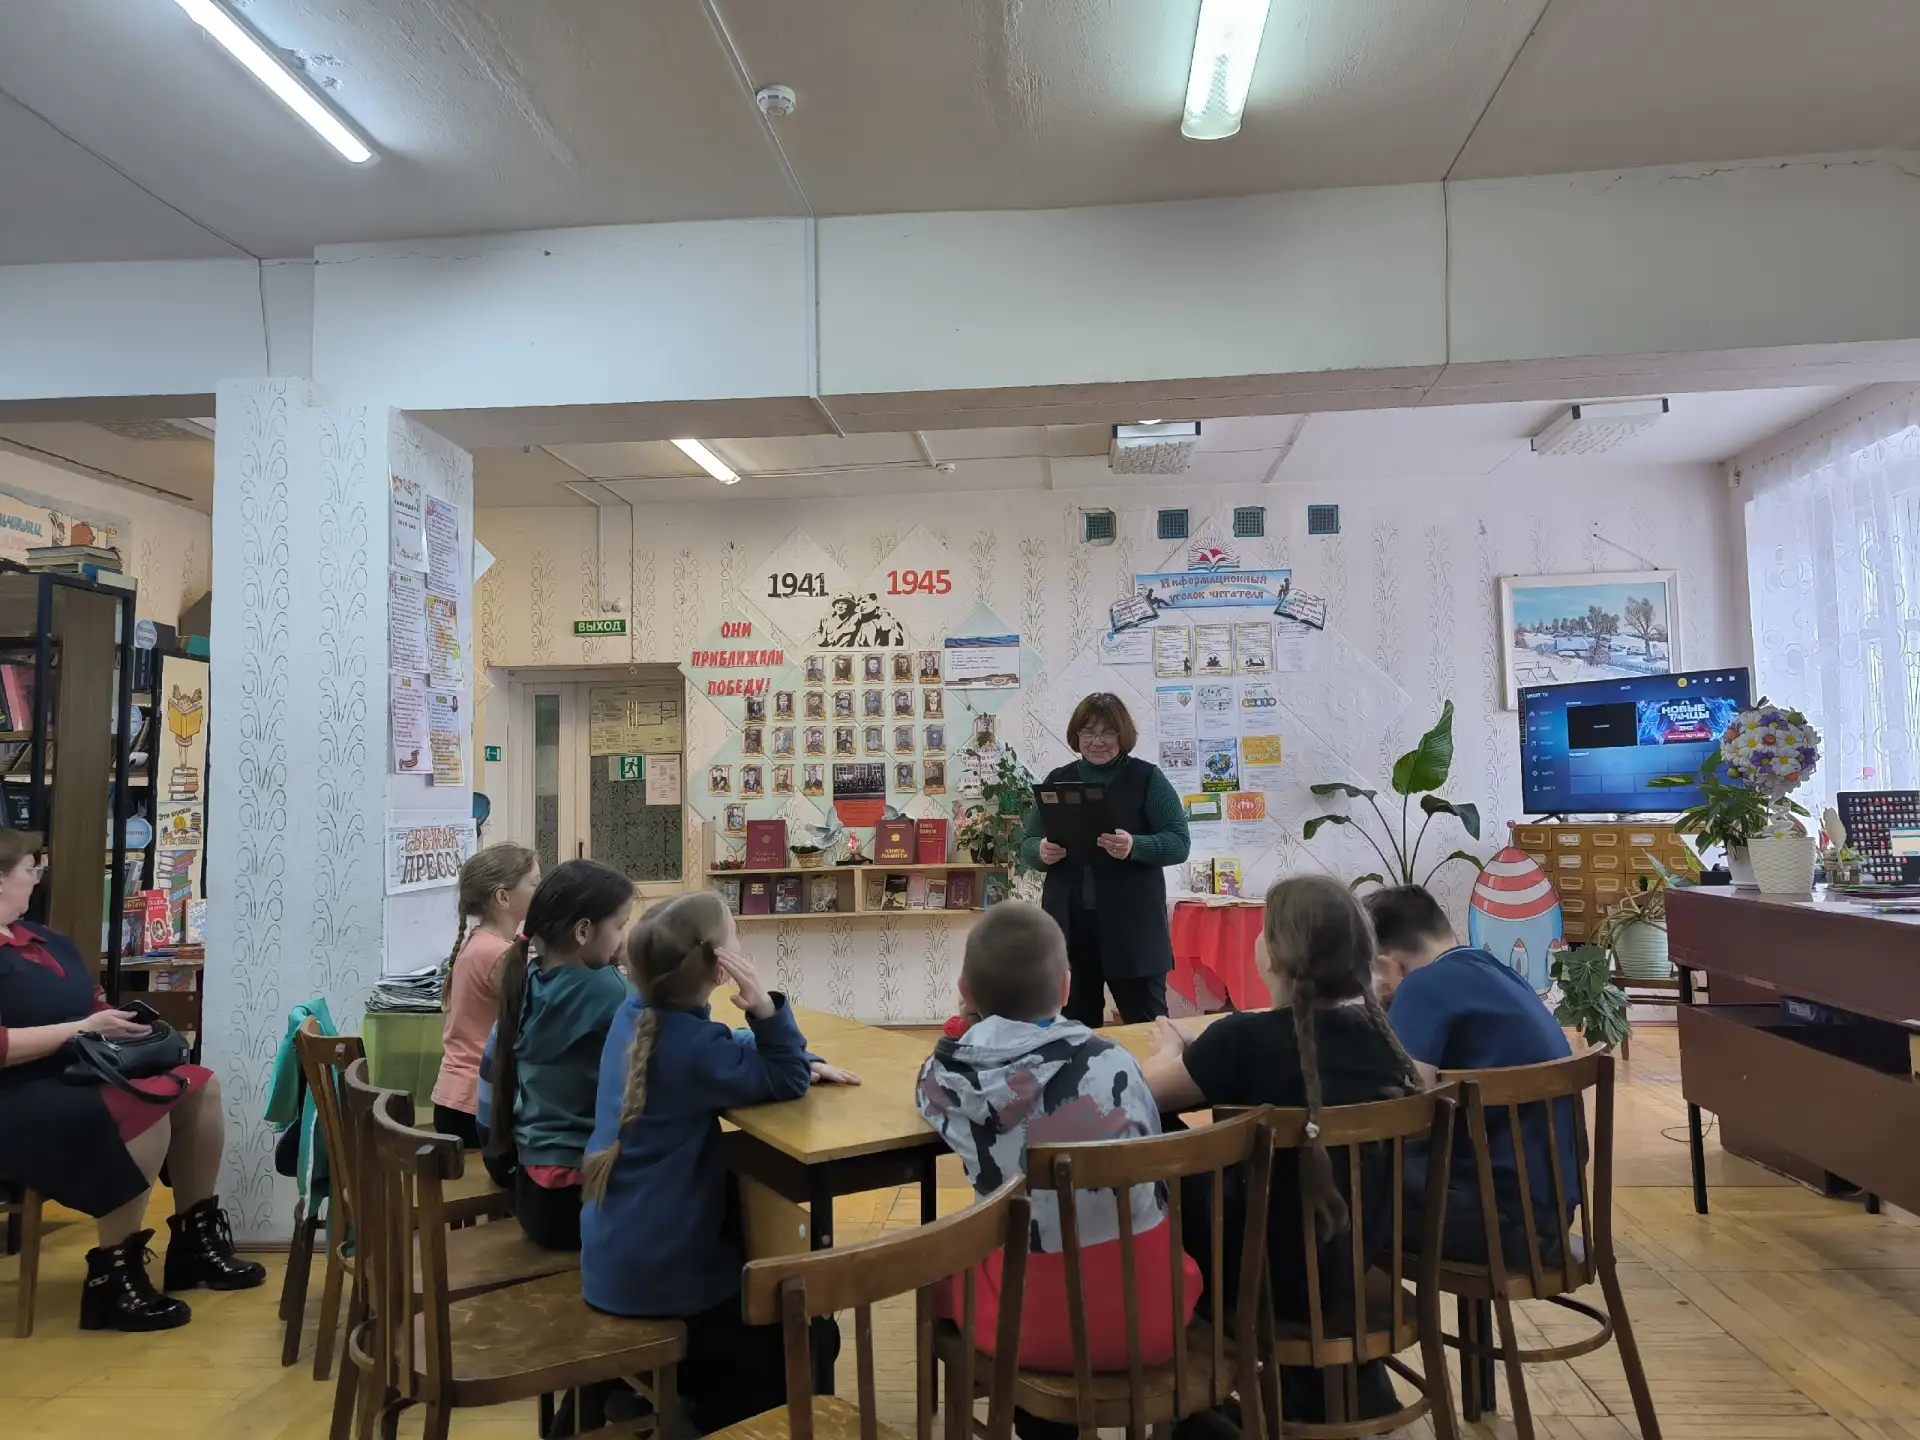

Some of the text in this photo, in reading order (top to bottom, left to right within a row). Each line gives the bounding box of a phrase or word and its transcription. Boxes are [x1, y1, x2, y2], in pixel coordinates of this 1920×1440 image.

[767, 572, 829, 598] 1941
[886, 569, 953, 596] 1945
[1159, 574, 1269, 590] Информационный
[1169, 590, 1265, 604] уголок читателя
[577, 620, 622, 633] ВЫХОД
[720, 621, 753, 639] ОНИ
[691, 649, 785, 668] ПРИБЛИЖАЛИ
[707, 677, 772, 697] ПОБЕДУ!
[1661, 703, 1706, 715] НОВЫЕ
[1667, 710, 1710, 722] ТАНЦЫ
[404, 826, 460, 852] СВЕЖАЯ
